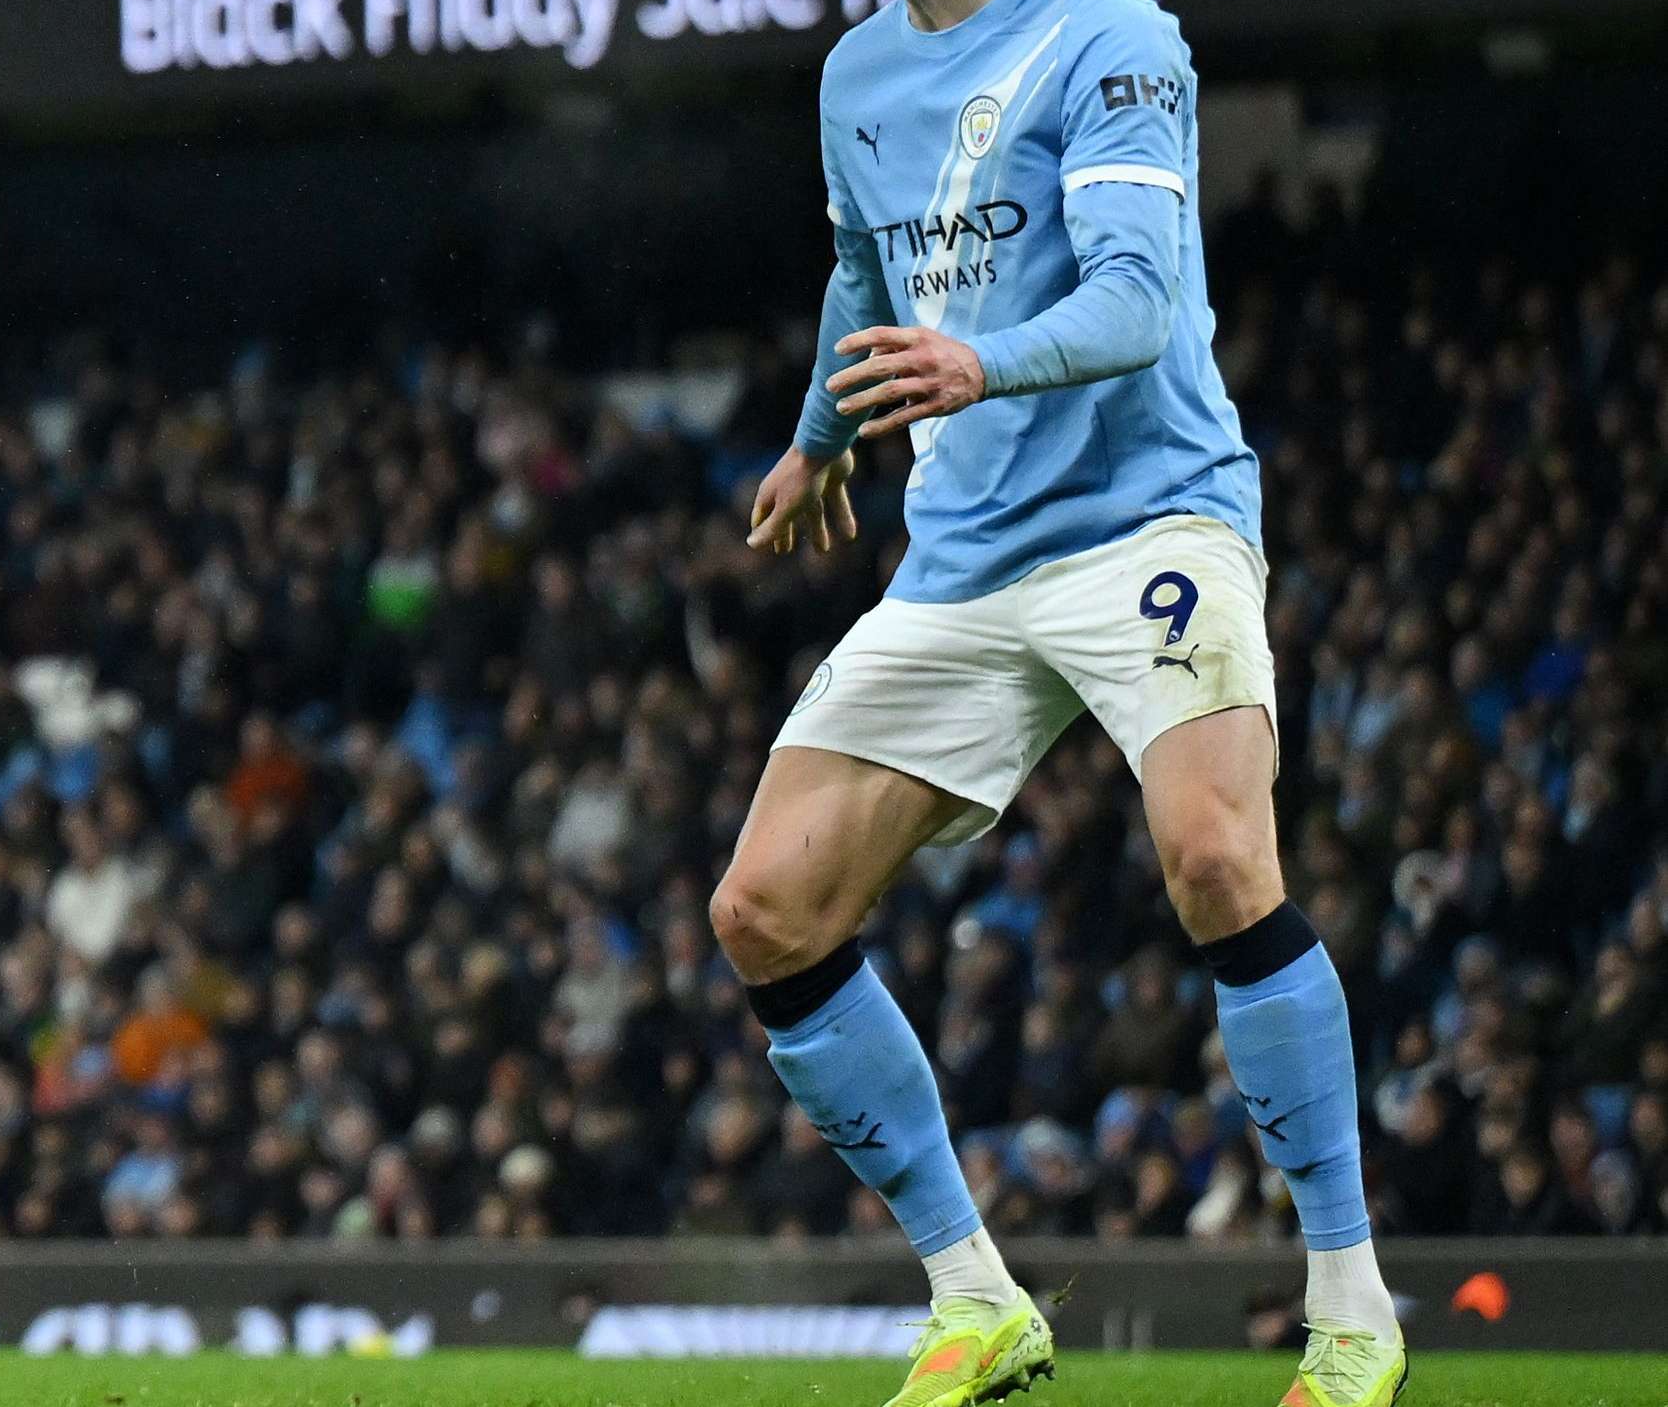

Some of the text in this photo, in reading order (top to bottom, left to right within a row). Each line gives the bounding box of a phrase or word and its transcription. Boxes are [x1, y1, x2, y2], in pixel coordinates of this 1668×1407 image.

[870, 199, 1029, 263] TIHAD
[903, 259, 997, 301] IRWAYS
[1139, 570, 1200, 647] 9
